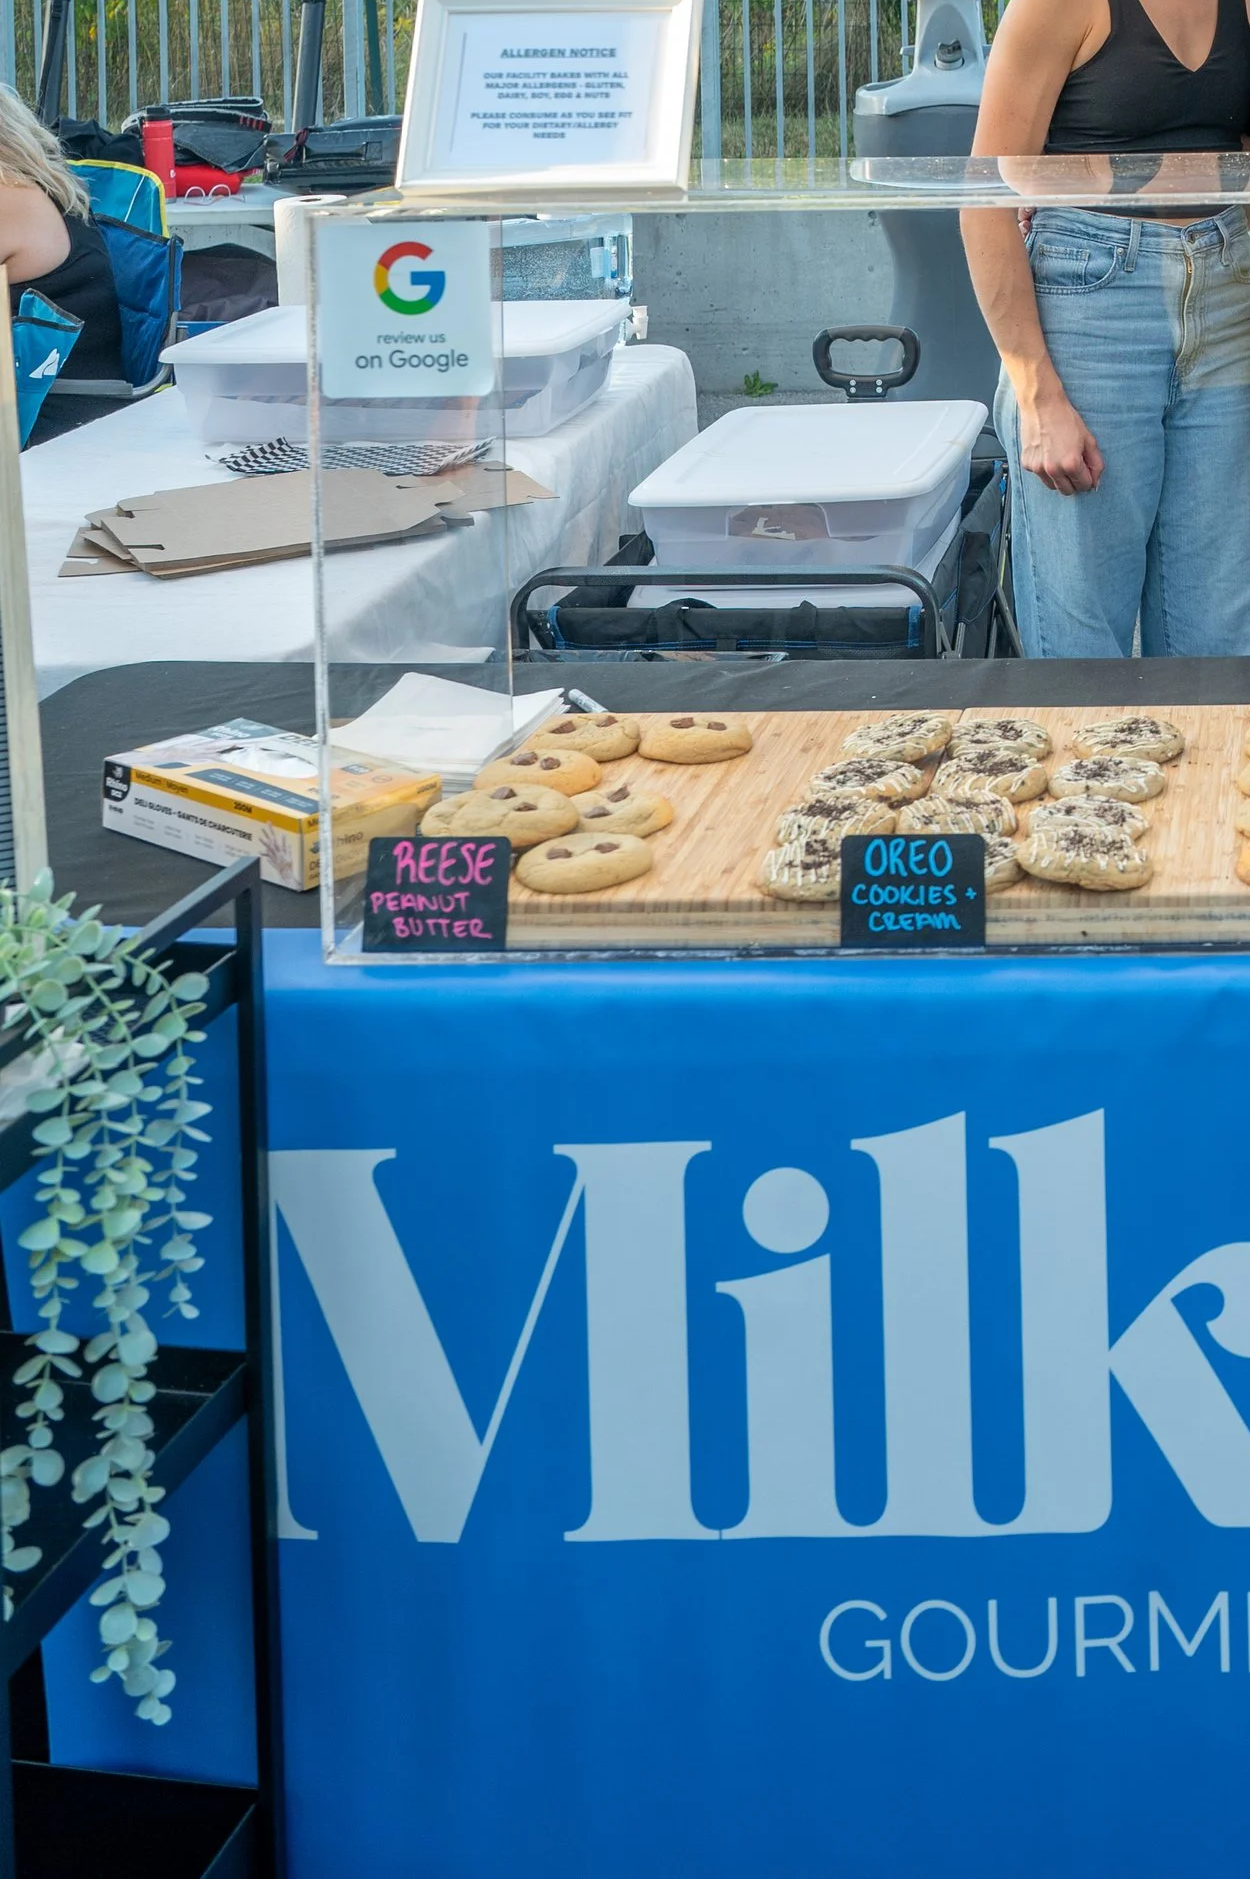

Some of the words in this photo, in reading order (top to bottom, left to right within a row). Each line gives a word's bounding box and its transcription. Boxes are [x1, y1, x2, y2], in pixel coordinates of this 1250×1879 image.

[500, 47, 566, 59] ALLERGEN
[570, 47, 617, 59] NOTICE
[598, 111, 615, 119] SEE
[377, 331, 425, 344] review
[429, 332, 446, 344] us
[355, 354, 383, 370] on
[389, 349, 469, 373] Google
[105, 777, 128, 792] Rhino
[148, 802, 173, 816] GLOVES
[177, 810, 199, 824] GANTS
[199, 817, 208, 827] DE
[208, 820, 253, 841] CHARCUTERIE
[392, 840, 496, 886] REESE
[864, 838, 953, 877] OREO
[370, 891, 470, 914] PEANUT
[851, 883, 957, 906] COOKIES
[964, 887, 977, 900] +
[392, 916, 493, 939] BUTTER
[868, 910, 961, 932] CREAM
